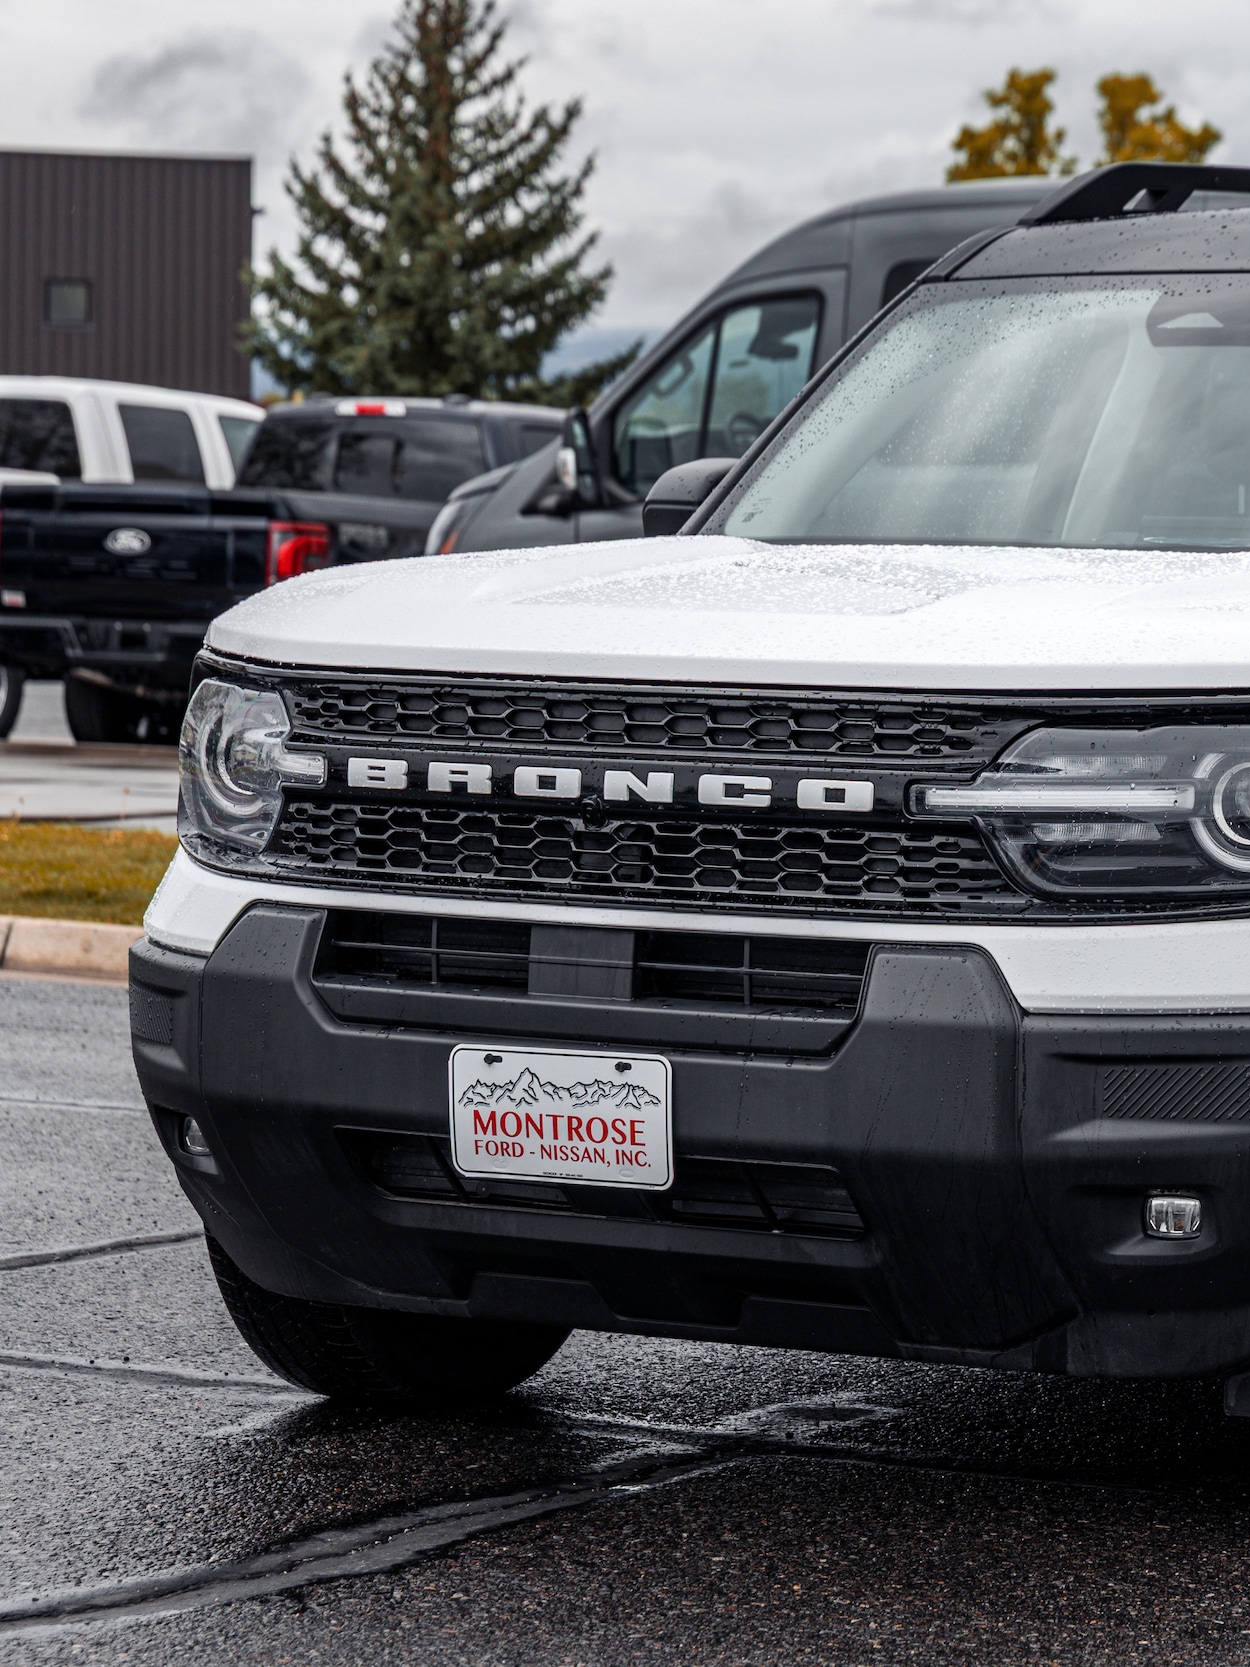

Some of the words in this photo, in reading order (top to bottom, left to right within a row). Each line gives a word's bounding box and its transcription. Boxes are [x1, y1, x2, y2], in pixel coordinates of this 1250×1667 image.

[347, 758, 875, 812] BRONCO
[473, 1109, 646, 1147] MONTROSE
[474, 1139, 525, 1158] FORD
[540, 1144, 611, 1168] NISSAN,
[615, 1149, 652, 1168] INC.
